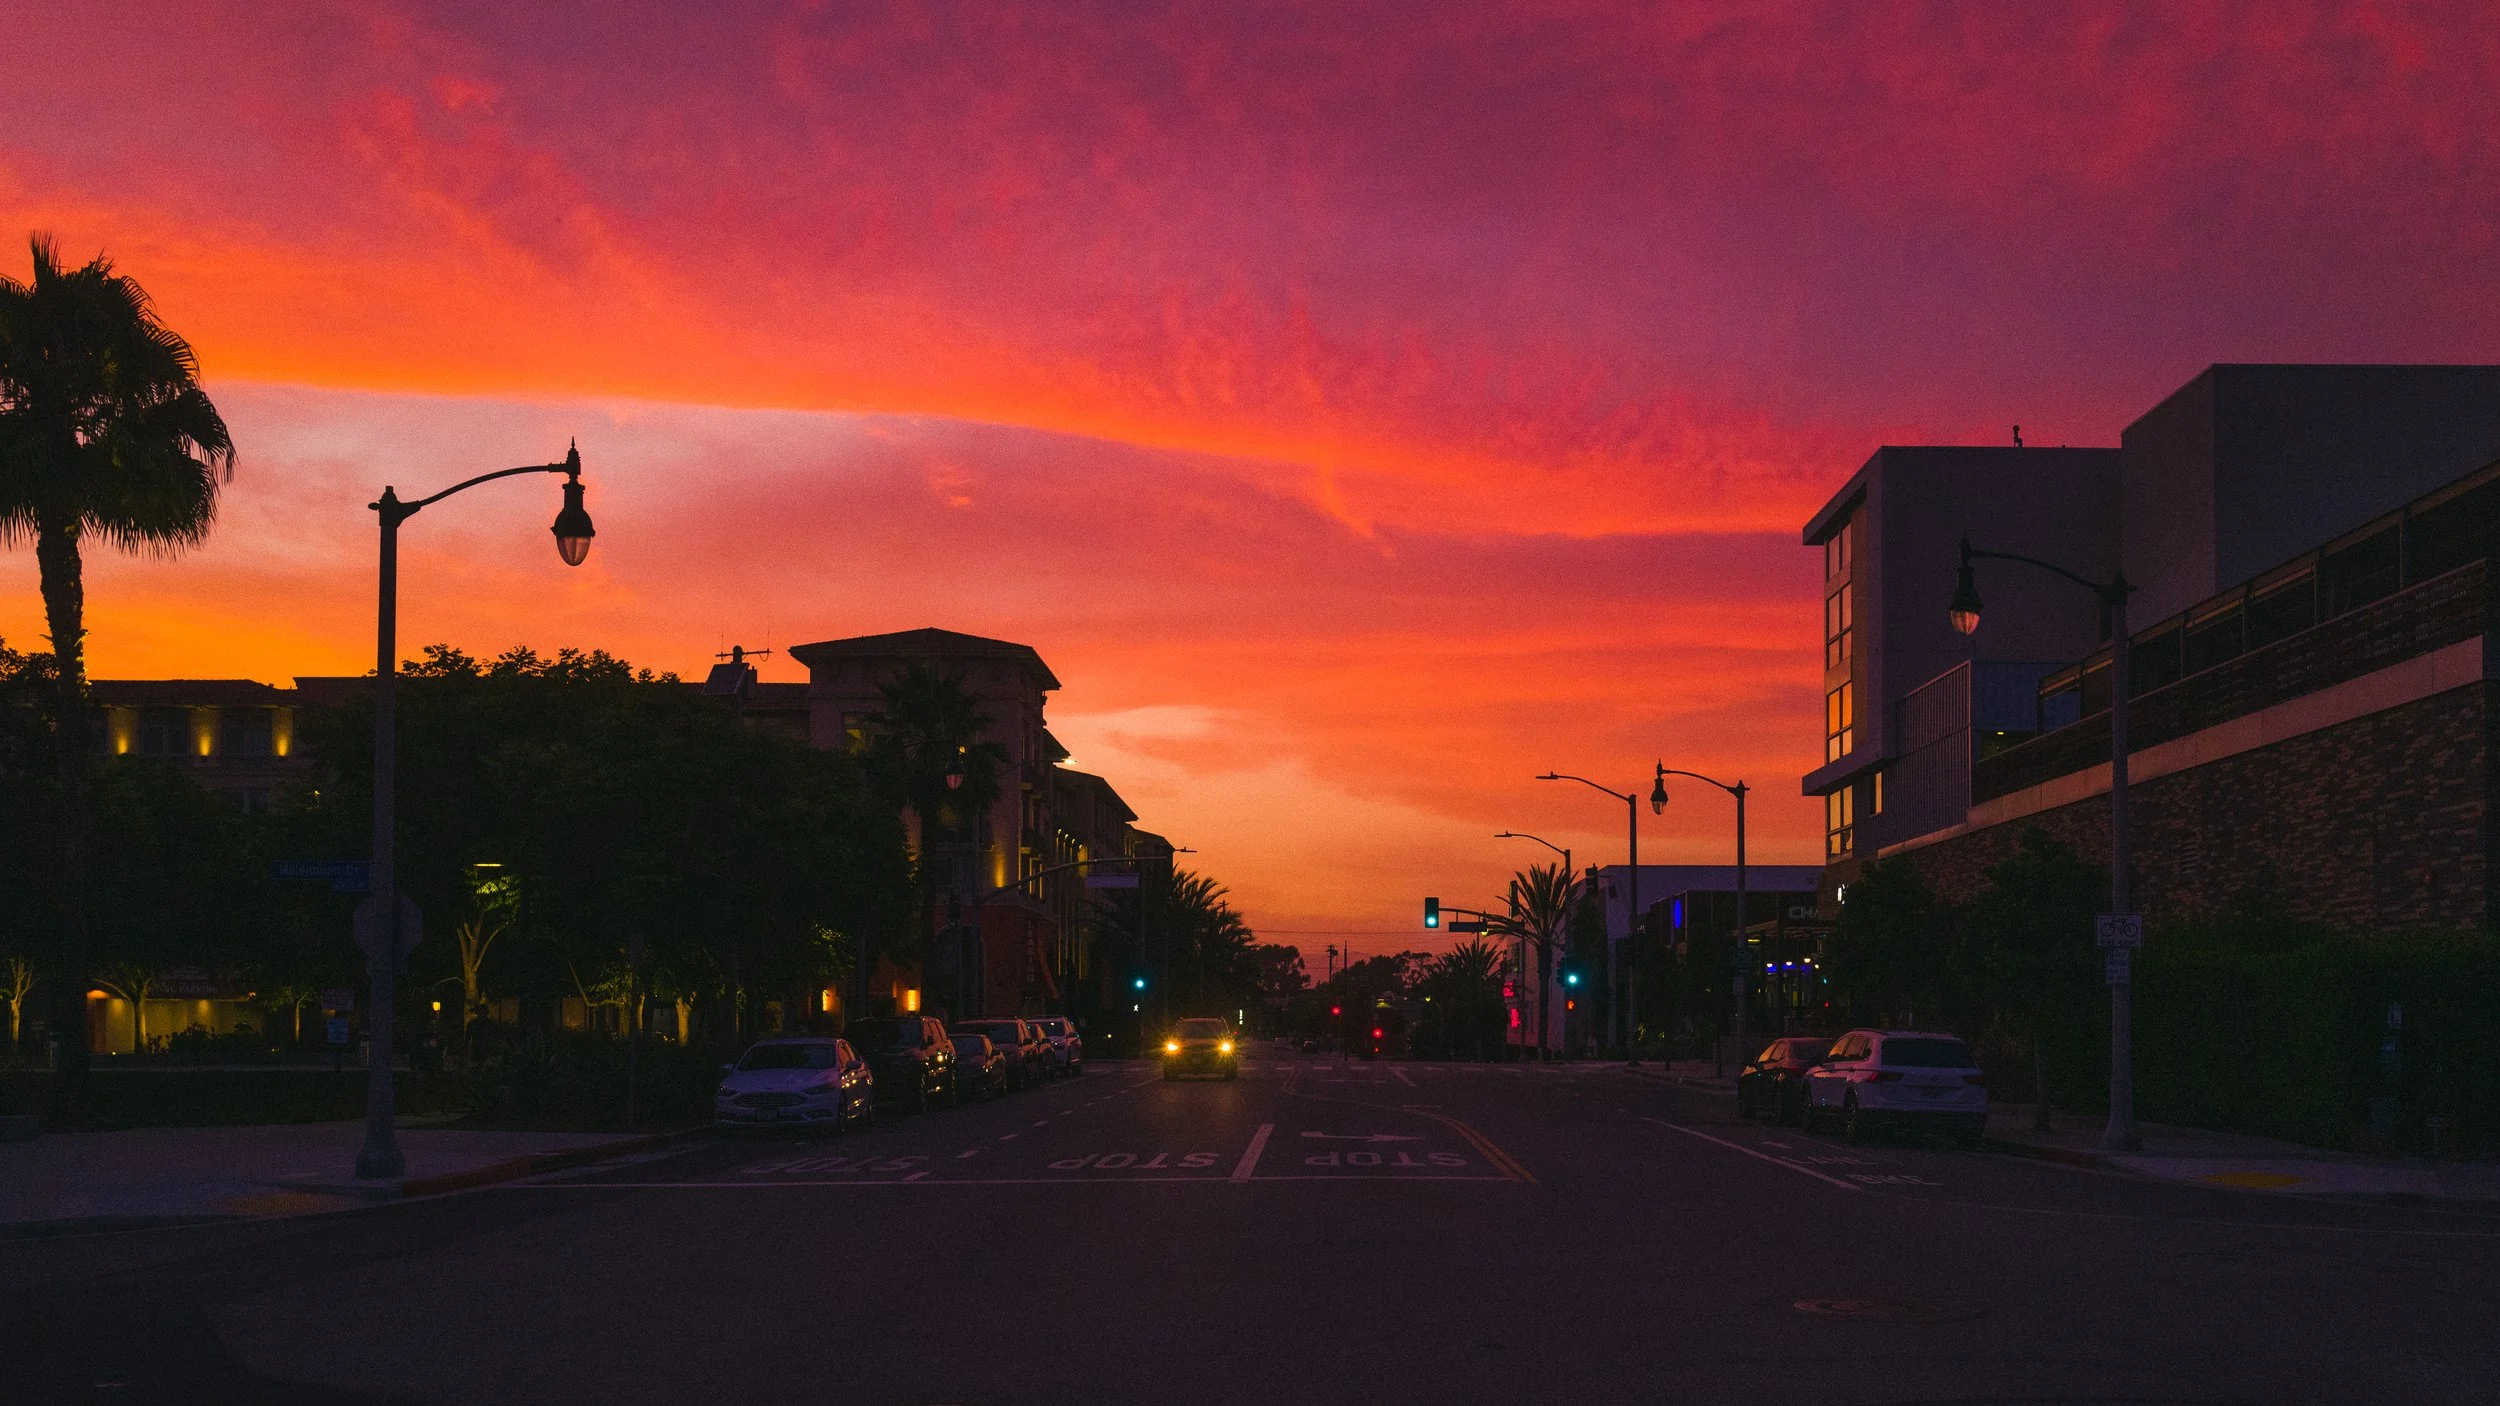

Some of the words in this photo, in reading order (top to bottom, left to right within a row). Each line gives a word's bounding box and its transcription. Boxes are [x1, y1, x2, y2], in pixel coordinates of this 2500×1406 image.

[279, 864, 341, 876] Millennium
[345, 864, 361, 876] Dr
[740, 1156, 929, 1174] STOP
[1047, 1152, 1220, 1169] STOP
[1304, 1151, 1469, 1167] STOP
